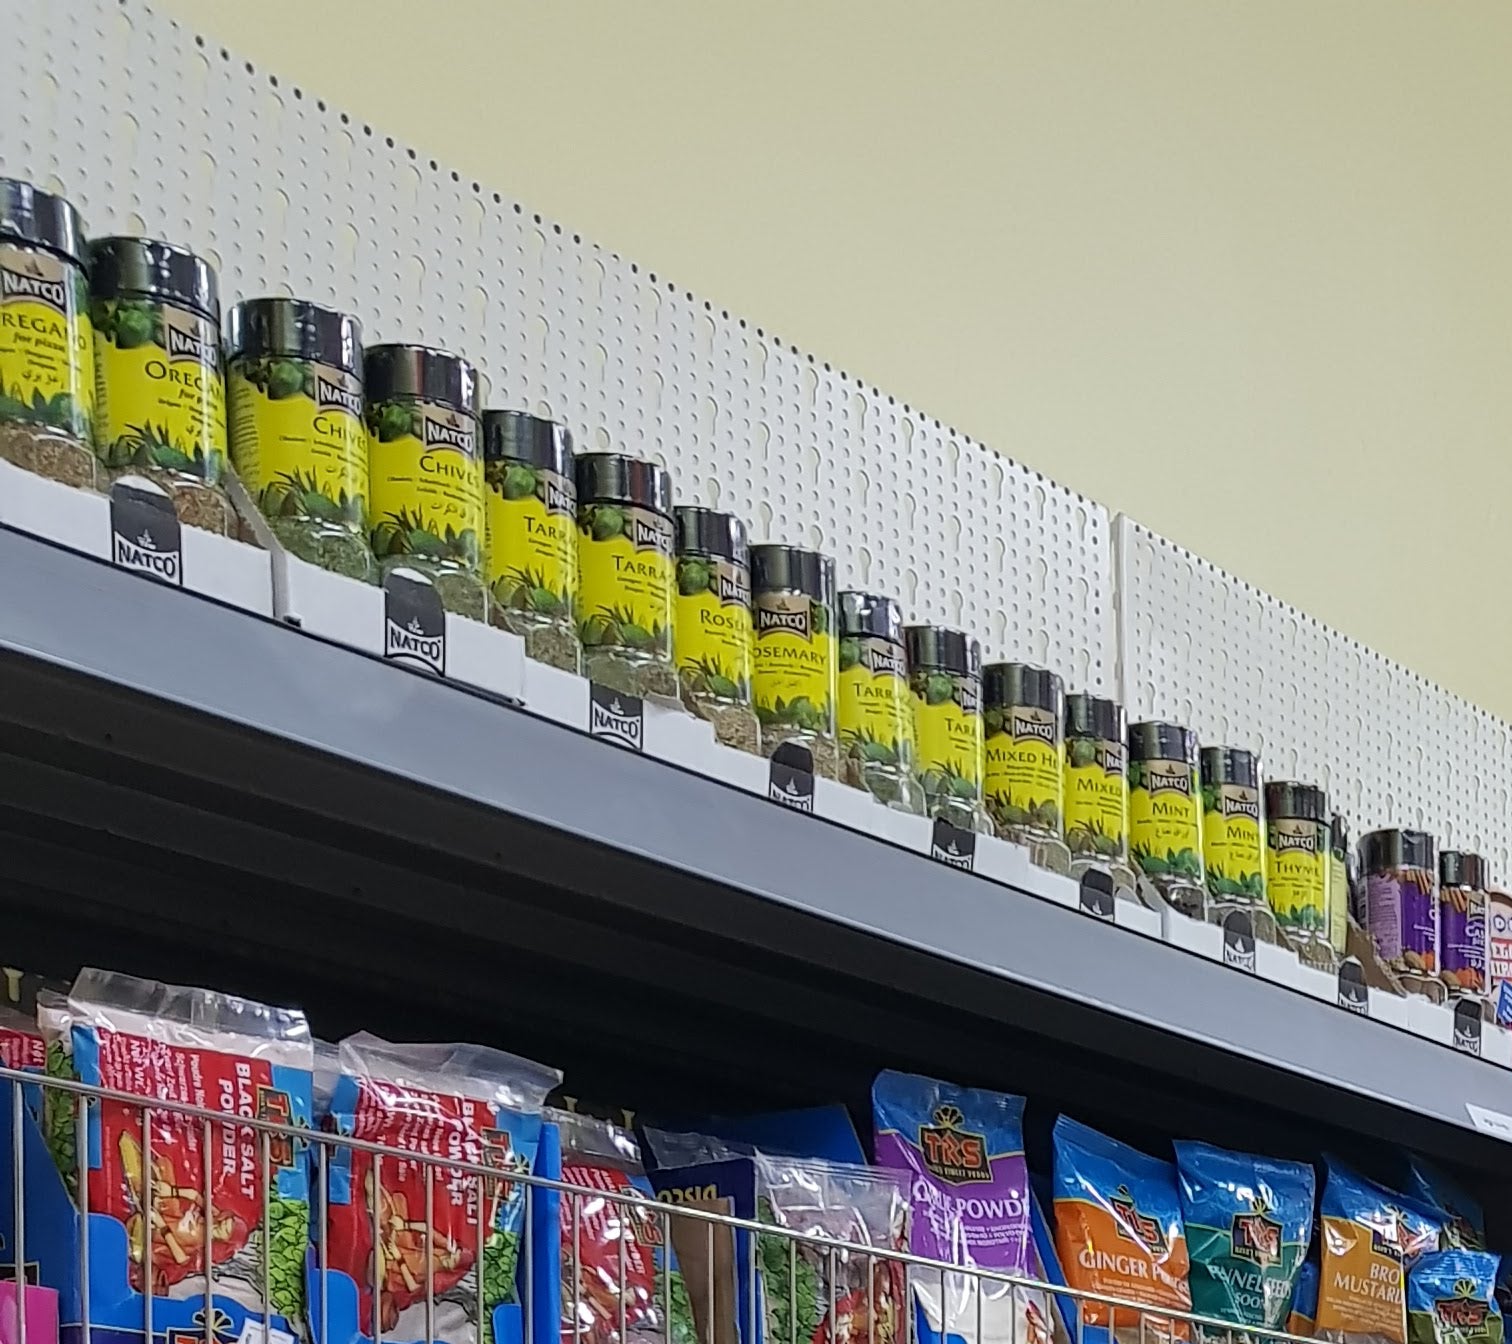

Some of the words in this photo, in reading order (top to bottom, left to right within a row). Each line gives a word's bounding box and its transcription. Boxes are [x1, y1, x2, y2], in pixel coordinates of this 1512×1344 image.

[3, 273, 64, 303] NATCO
[426, 422, 474, 454] NATCO
[418, 455, 480, 489] CHIVES
[117, 544, 179, 578] NATCO
[759, 611, 807, 630] NATCO
[594, 707, 640, 740] NATCO
[1015, 721, 1054, 742] NATCO
[986, 748, 1038, 766] MIXED
[1151, 772, 1188, 792] NATCO
[1152, 801, 1190, 818] MINT
[1225, 798, 1259, 817] NATCO
[1278, 833, 1316, 851] NATCO
[925, 1132, 982, 1167] TRS
[238, 1143, 255, 1200] SALT
[1079, 1248, 1148, 1278] GINGER
